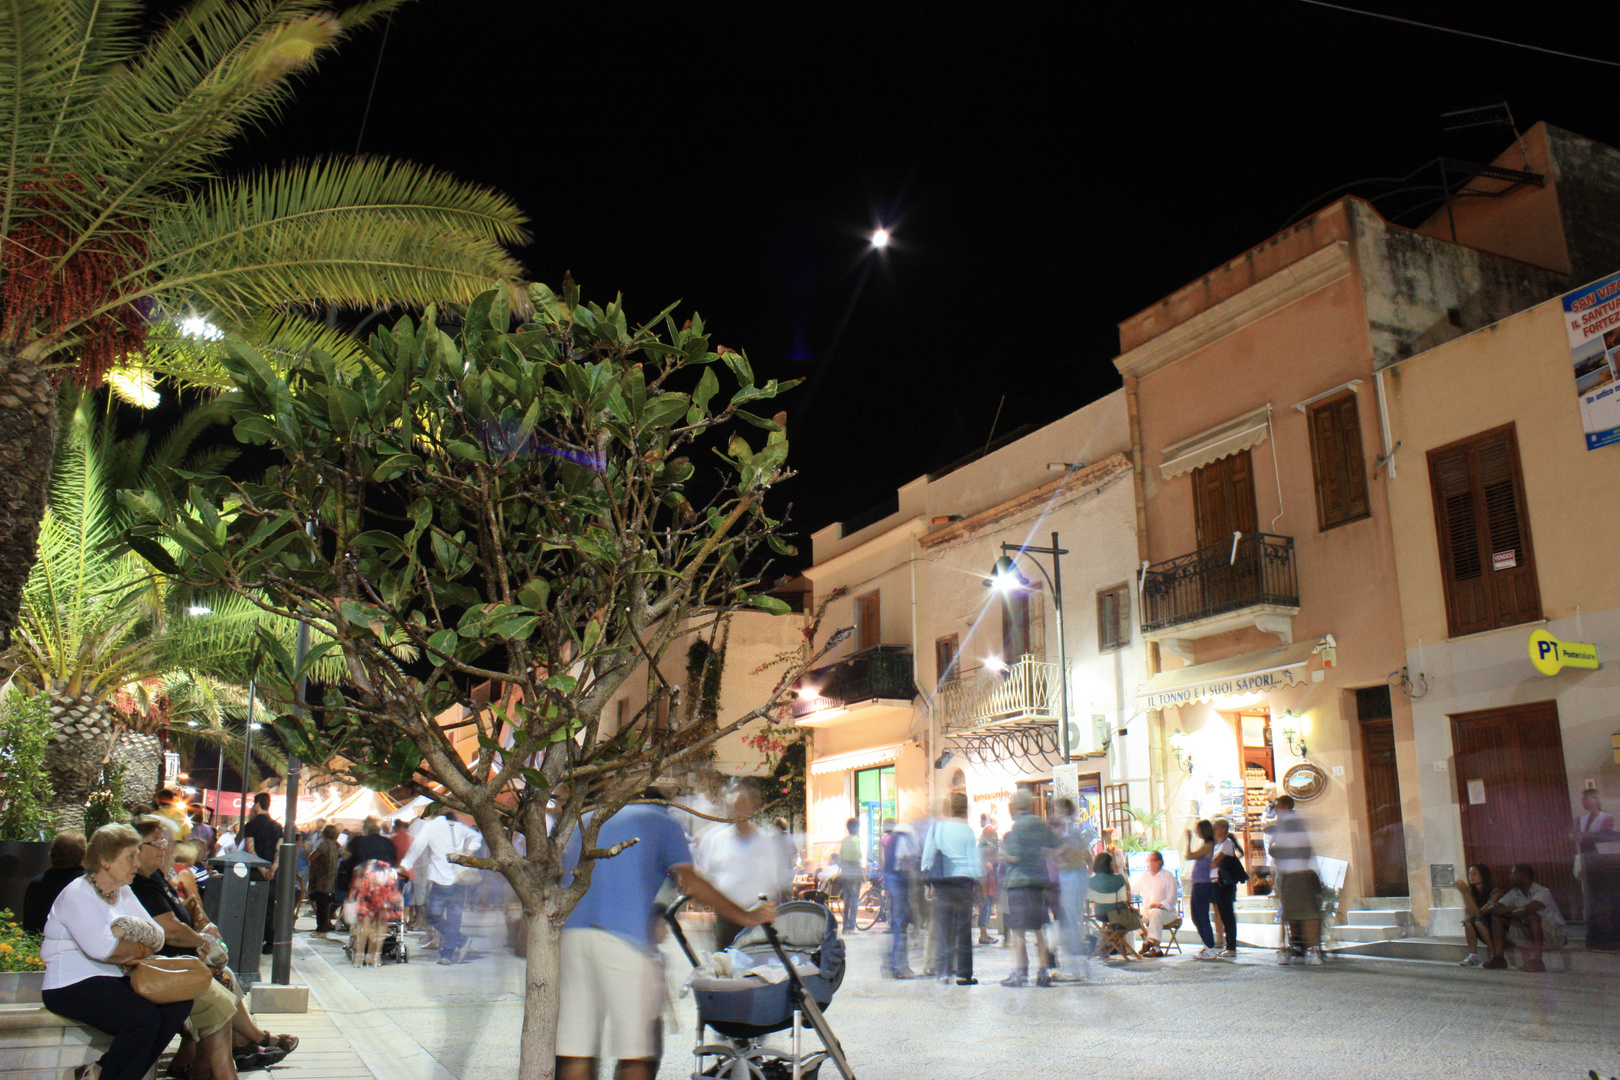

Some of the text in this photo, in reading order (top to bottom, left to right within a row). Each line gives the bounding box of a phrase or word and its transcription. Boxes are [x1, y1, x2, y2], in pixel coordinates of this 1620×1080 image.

[1571, 292, 1597, 313] SAN
[1571, 319, 1580, 330] IL
[1586, 396, 1595, 404] Un
[1596, 388, 1614, 400] antico
[1537, 641, 1559, 661] PT
[1148, 673, 1282, 707] IL TONNO E I SUOI SAPORI...
